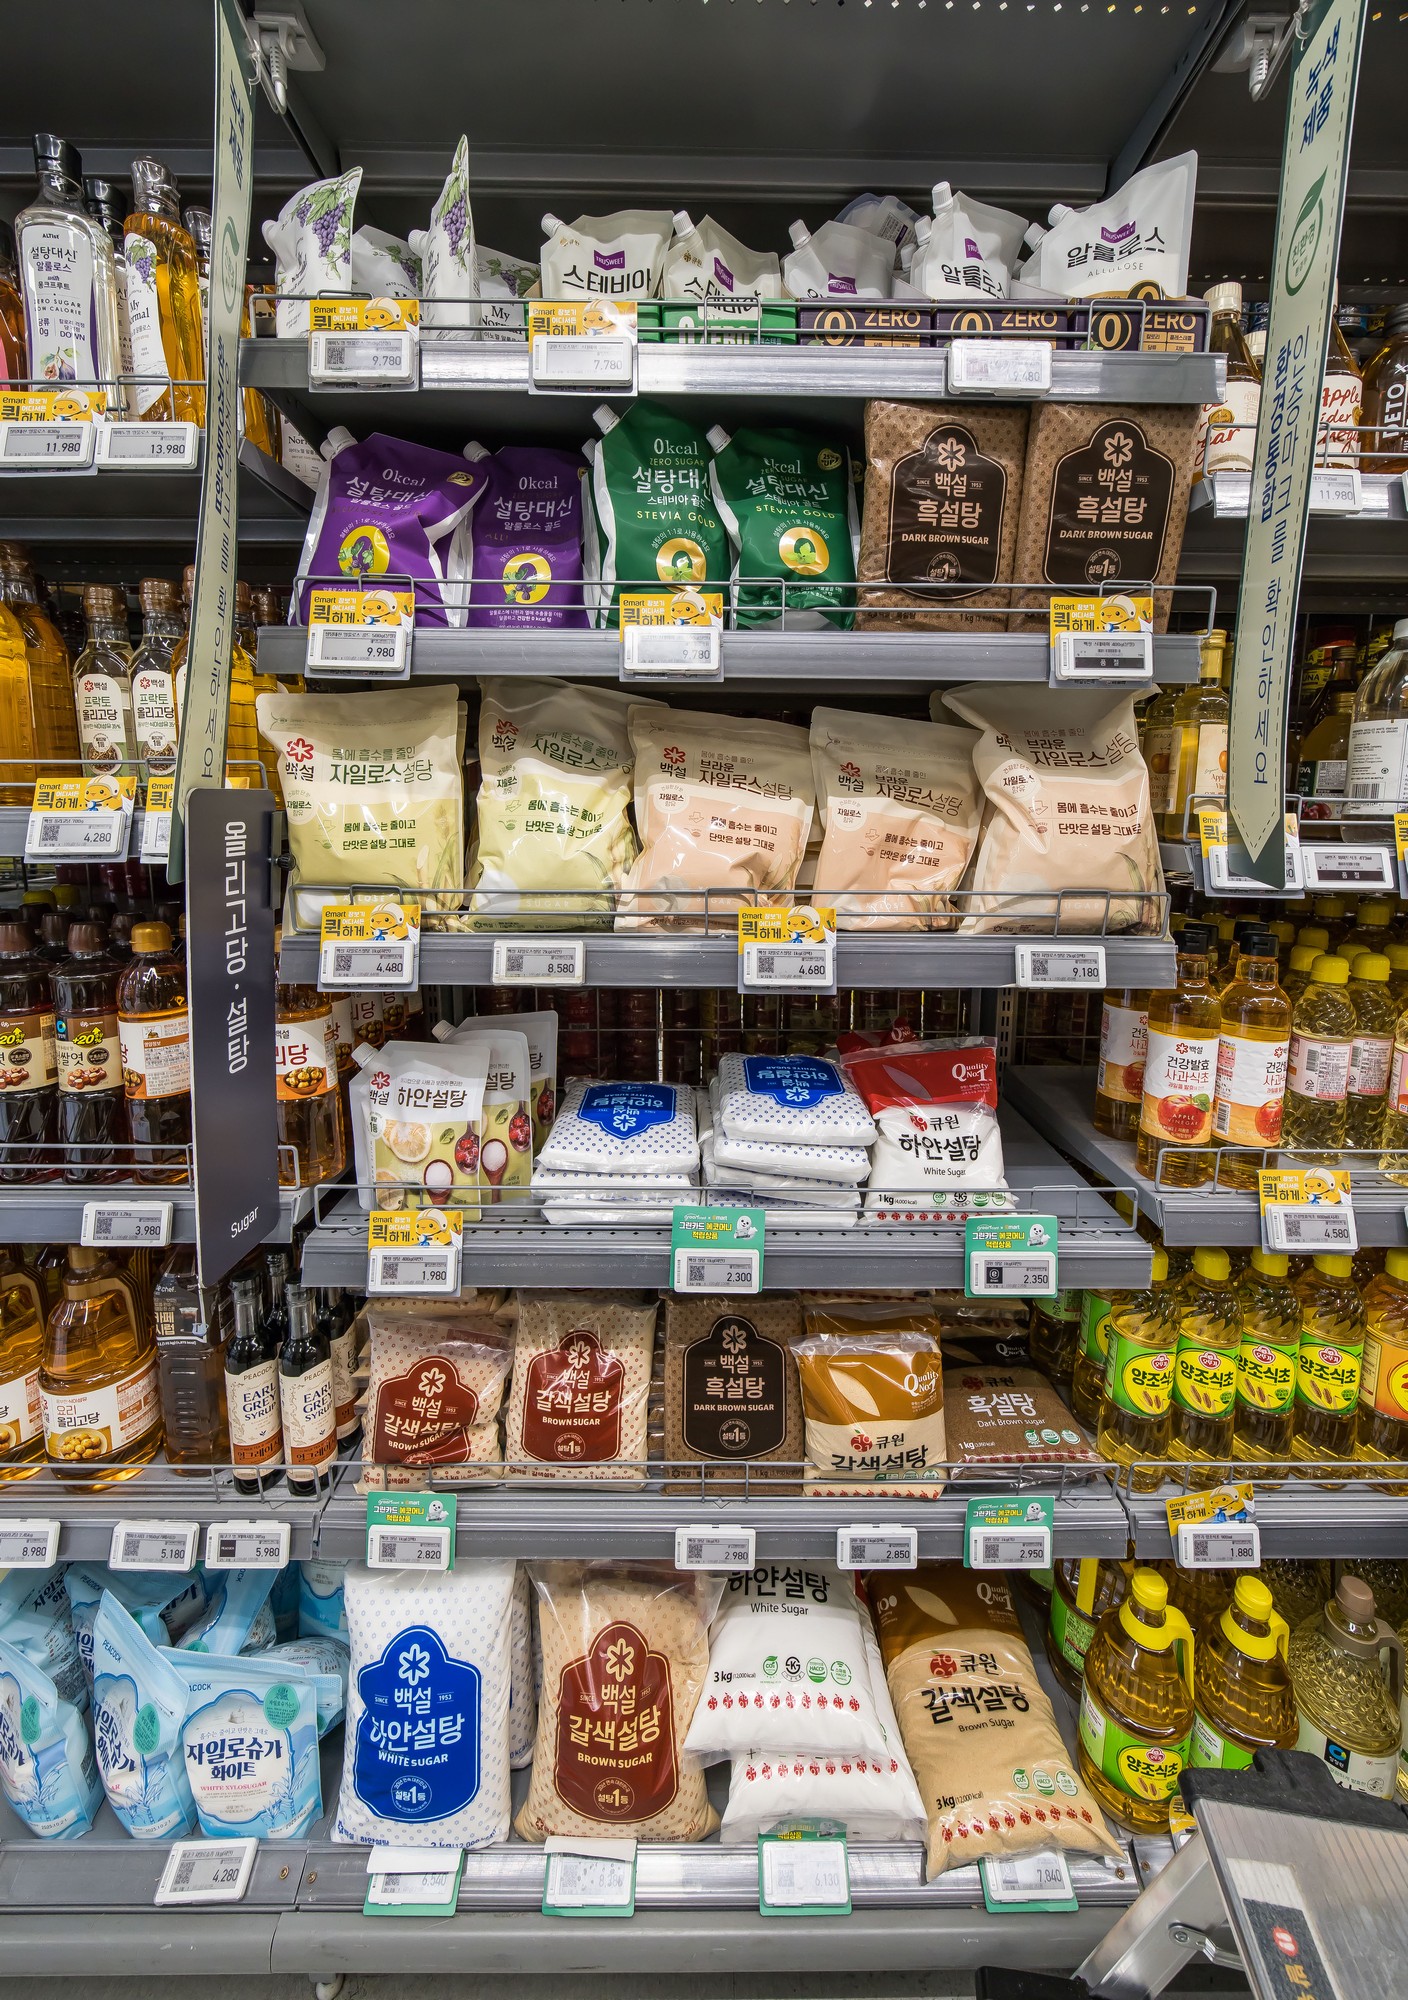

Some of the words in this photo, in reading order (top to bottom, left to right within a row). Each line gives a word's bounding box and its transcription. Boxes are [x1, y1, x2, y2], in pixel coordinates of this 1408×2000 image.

[1299, 75, 1335, 154] 제품
[31, 247, 77, 263] 설탕대신
[1067, 227, 1166, 269] 알룰로스
[37, 261, 72, 273] 알룰로스
[595, 256, 624, 266] TRUSWEET
[865, 310, 921, 328] ZERO
[1001, 310, 1058, 328] ZERO
[654, 438, 699, 455] 0kcal
[650, 458, 671, 466] ZERO
[675, 458, 704, 467] SUGAR
[382, 468, 425, 487] 0kcal
[519, 476, 558, 490] 0kcal
[746, 475, 829, 500] 설탕대신
[494, 495, 573, 521] 설탕대신
[756, 504, 798, 516] STEVIA
[804, 509, 835, 519] GOLD
[917, 499, 982, 528] 흑설탕
[1076, 495, 1147, 524] 흑설탕
[504, 521, 541, 531] 알룰로스
[637, 510, 681, 521] STEVIA
[688, 512, 716, 529] GOLD
[902, 533, 927, 543] DARK
[928, 534, 961, 544] BROWN
[962, 535, 989, 545] SUGAR
[1059, 530, 1084, 539] DARK
[1087, 530, 1122, 539] BROWN
[1124, 530, 1153, 540] SUGAR
[94, 682, 108, 691] 백설
[151, 678, 164, 687] 백설
[1254, 576, 1282, 785] 확인하세요
[84, 696, 110, 708] 프락토
[140, 693, 168, 705] 프락토
[82, 708, 117, 722] 올리고당
[286, 763, 315, 782] 백설
[330, 759, 433, 785] 자일로스설탕
[660, 762, 686, 779] 백설
[700, 760, 734, 772] 브라운
[699, 770, 794, 801] 자일로스설탕
[838, 775, 864, 792] 백설
[875, 775, 908, 785] 브라운
[876, 782, 963, 816] 자일로스설탕
[1057, 803, 1077, 813] 몸에
[1080, 803, 1108, 816] 흡수는
[223, 820, 248, 975] 올리고당
[226, 997, 249, 1075] 설탕
[1189, 1045, 1203, 1054] 백설
[1167, 1055, 1209, 1071] 건강발효
[1164, 1069, 1209, 1084] 사과식초
[398, 1087, 468, 1109] 하얀설탕
[929, 1114, 959, 1131] 큐원
[1168, 1118, 1198, 1126] VINEGAR
[899, 1134, 981, 1162] 하얀설탕
[924, 1167, 945, 1176] White
[947, 1168, 966, 1177] Sugar
[230, 1206, 259, 1238] Sugar
[156, 1324, 175, 1335] 시럽
[1180, 1361, 1234, 1387] 양조식초
[1238, 1357, 1290, 1384] 양조식초
[1300, 1357, 1356, 1385] 양조식초
[706, 1377, 765, 1399] 흑설탕
[985, 1376, 1016, 1387] 큐원
[243, 1383, 276, 1402] EARL
[243, 1390, 276, 1412] GREY
[57, 1405, 76, 1415] 요리
[245, 1402, 276, 1422] SYRUP
[694, 1403, 716, 1412] DARK
[717, 1404, 747, 1412] BROWN
[748, 1404, 774, 1412] SUGAR
[967, 1393, 1037, 1417] 흑설탕
[57, 1412, 100, 1427] 올리고당
[542, 1416, 572, 1426] BROWN
[573, 1418, 600, 1426] SUGAR
[388, 1439, 418, 1451] BROWN
[419, 1431, 445, 1448] SUGAR
[875, 1432, 905, 1448] 큐원
[728, 1567, 830, 1603] 하얀설탕
[751, 1603, 779, 1614] White
[782, 1604, 809, 1617] Sugar
[101, 1639, 122, 1663] PEACOCK
[960, 1654, 998, 1676] 큐원
[601, 1685, 636, 1715] 백설
[921, 1685, 1030, 1725] 갈색설탕
[370, 1713, 466, 1753] 하얀설탕
[569, 1705, 661, 1751] 갈색설탕
[958, 1719, 988, 1733] Brown
[989, 1719, 1016, 1730] Sugar
[187, 1737, 282, 1765] 자일로슈가
[378, 1750, 409, 1768] WHITE
[411, 1753, 449, 1767] SUGAR
[577, 1753, 617, 1768] BROWN
[618, 1753, 653, 1768] SUGAR
[1126, 1755, 1178, 1779] 양조식초
[211, 1762, 256, 1781] 화이트
[226, 1781, 267, 1790] XYLOSUGAR
